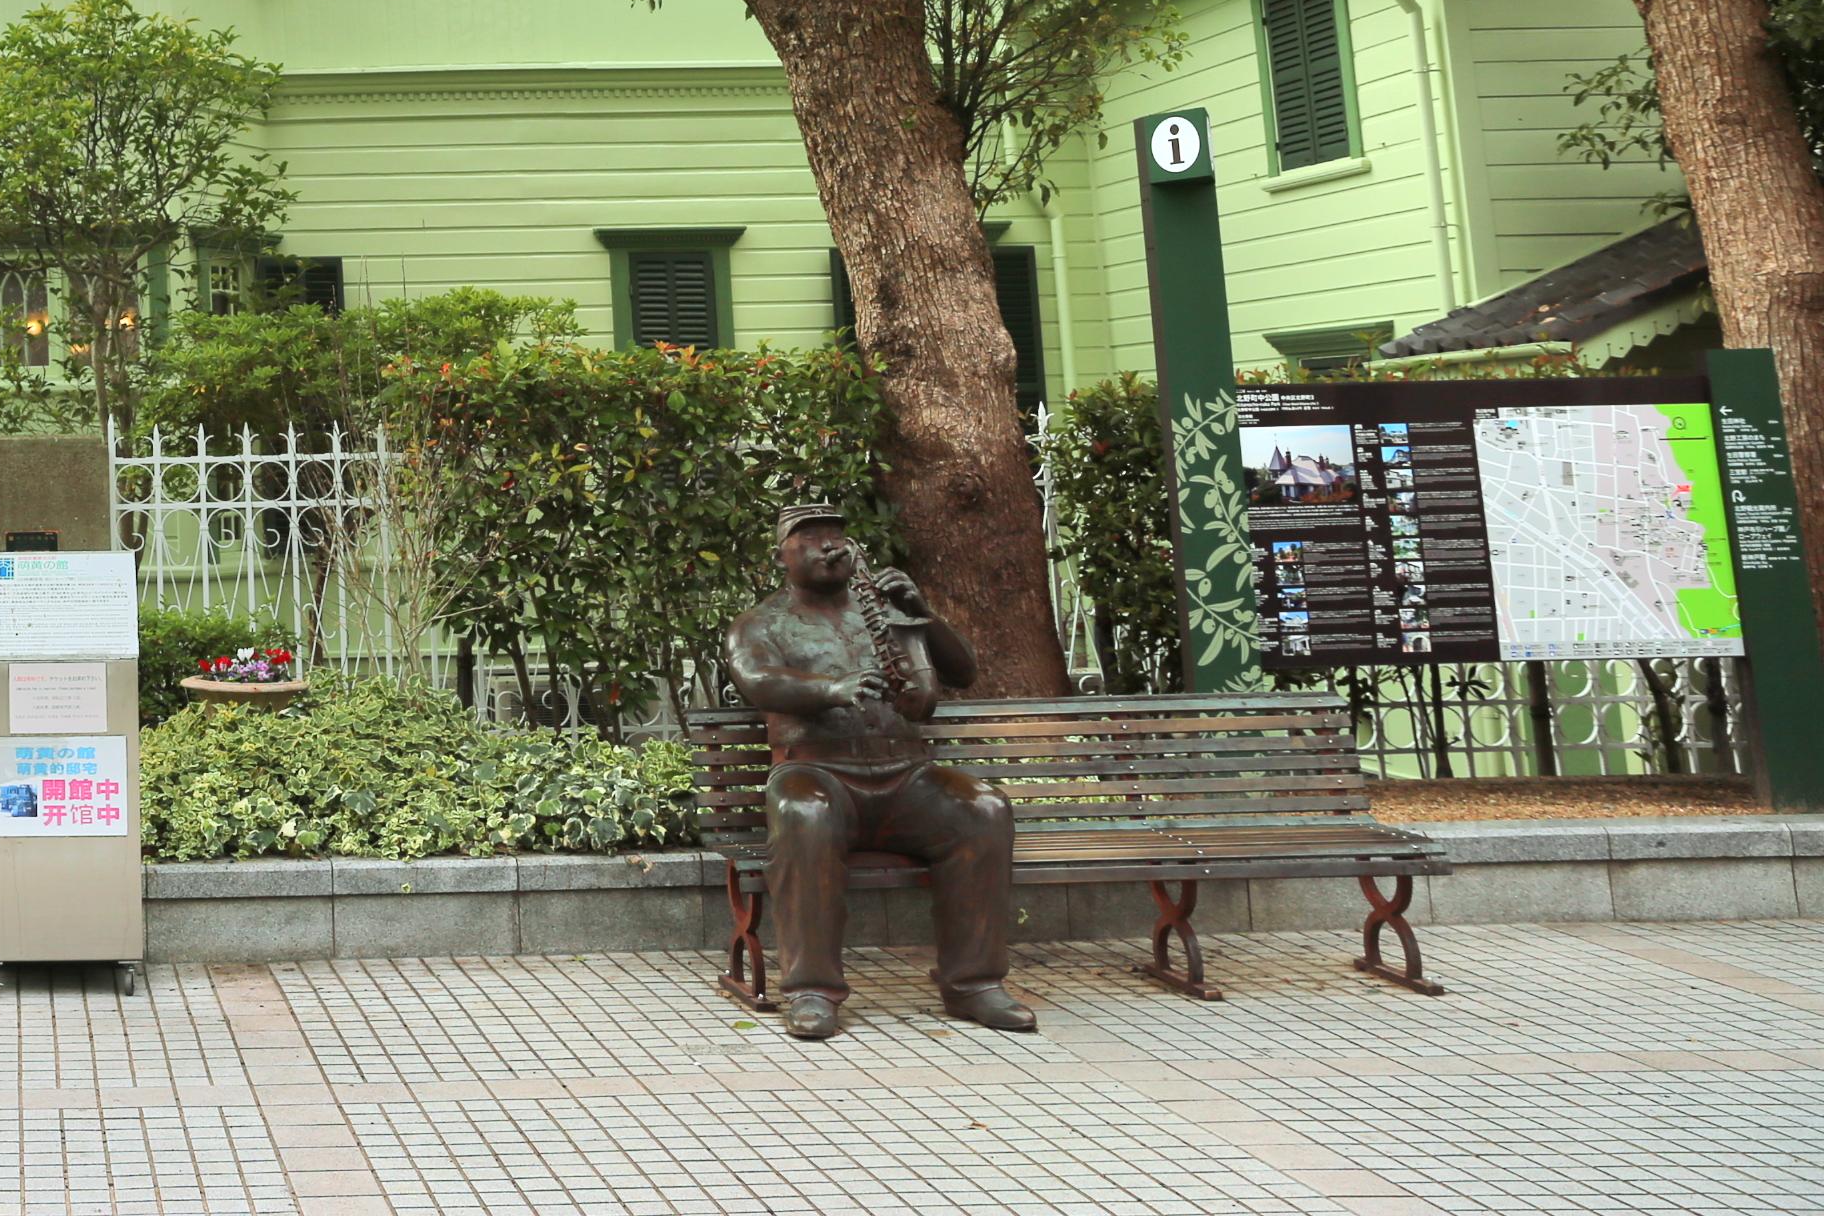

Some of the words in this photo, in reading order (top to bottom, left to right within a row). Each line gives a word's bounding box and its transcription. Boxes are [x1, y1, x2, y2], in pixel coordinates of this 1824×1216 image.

[1168, 124, 1185, 165] i
[16, 747, 96, 759] 萌黄の館
[42, 779, 119, 801] 開館中
[42, 804, 120, 826] 开馆中
